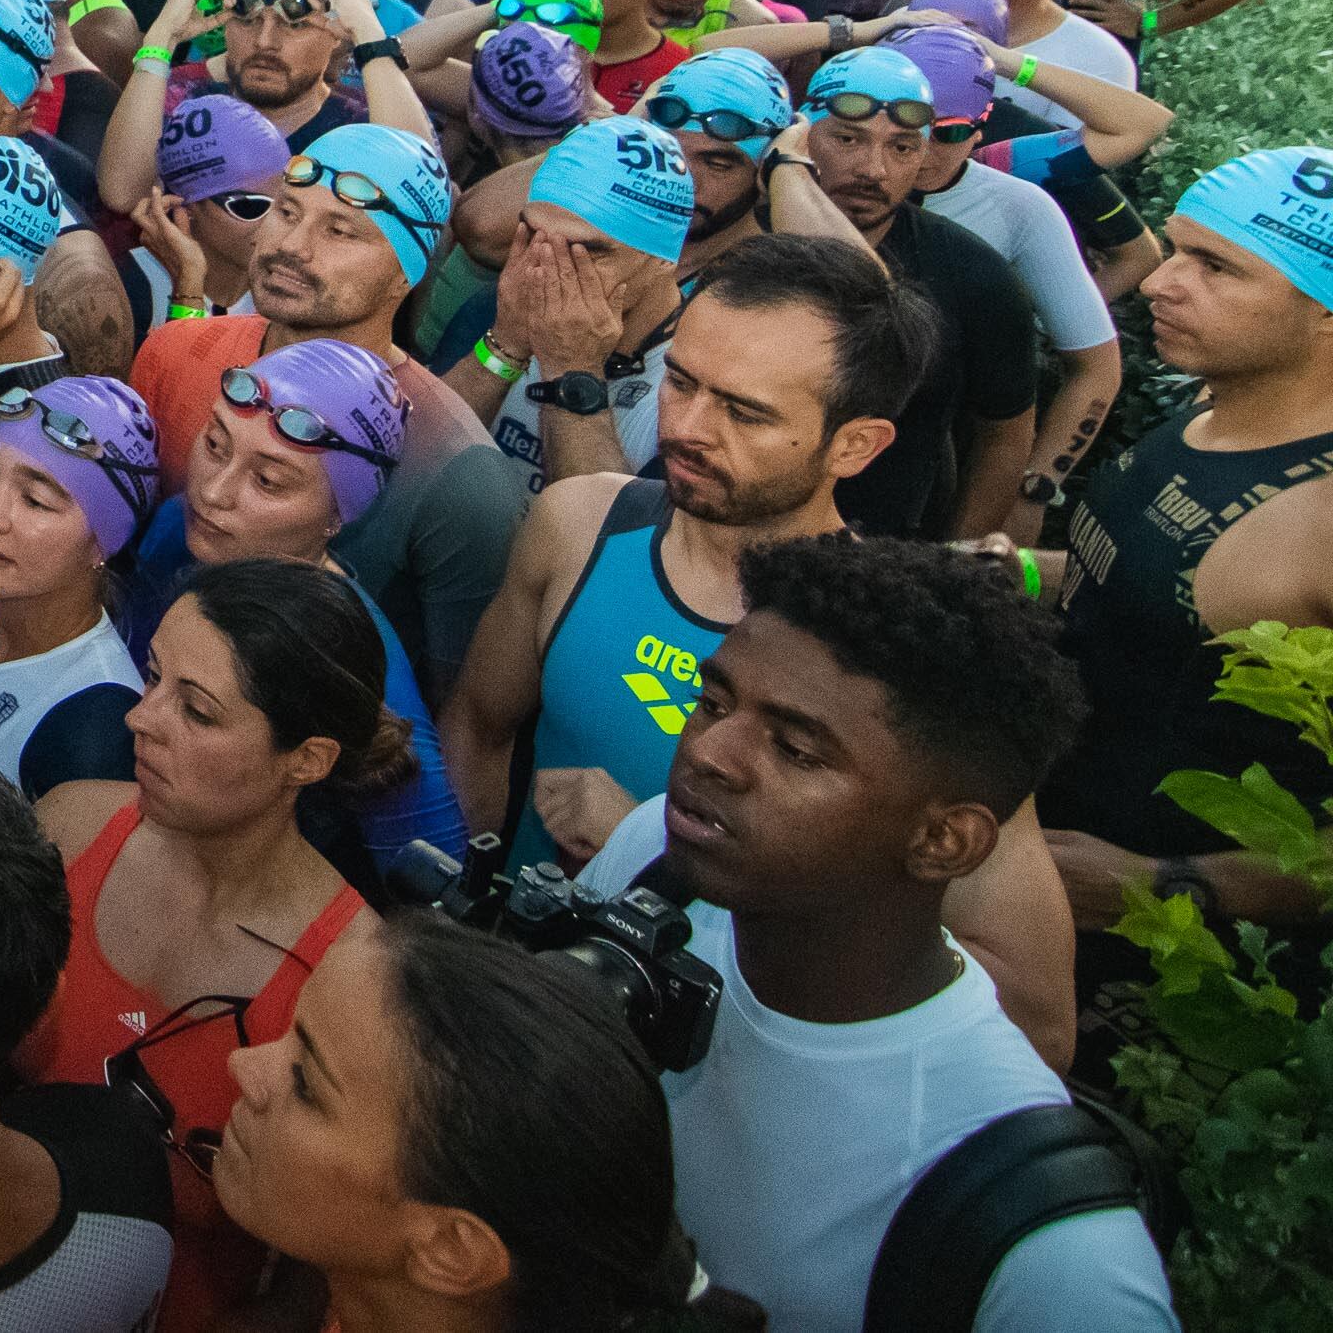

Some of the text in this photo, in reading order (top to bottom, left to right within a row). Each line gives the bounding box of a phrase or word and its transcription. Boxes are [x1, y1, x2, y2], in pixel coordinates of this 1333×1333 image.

[1292, 156, 1333, 200] 5
[1143, 504, 1187, 542] TRIATLON
[1152, 474, 1213, 531] TRIBU
[606, 913, 645, 940] SONY
